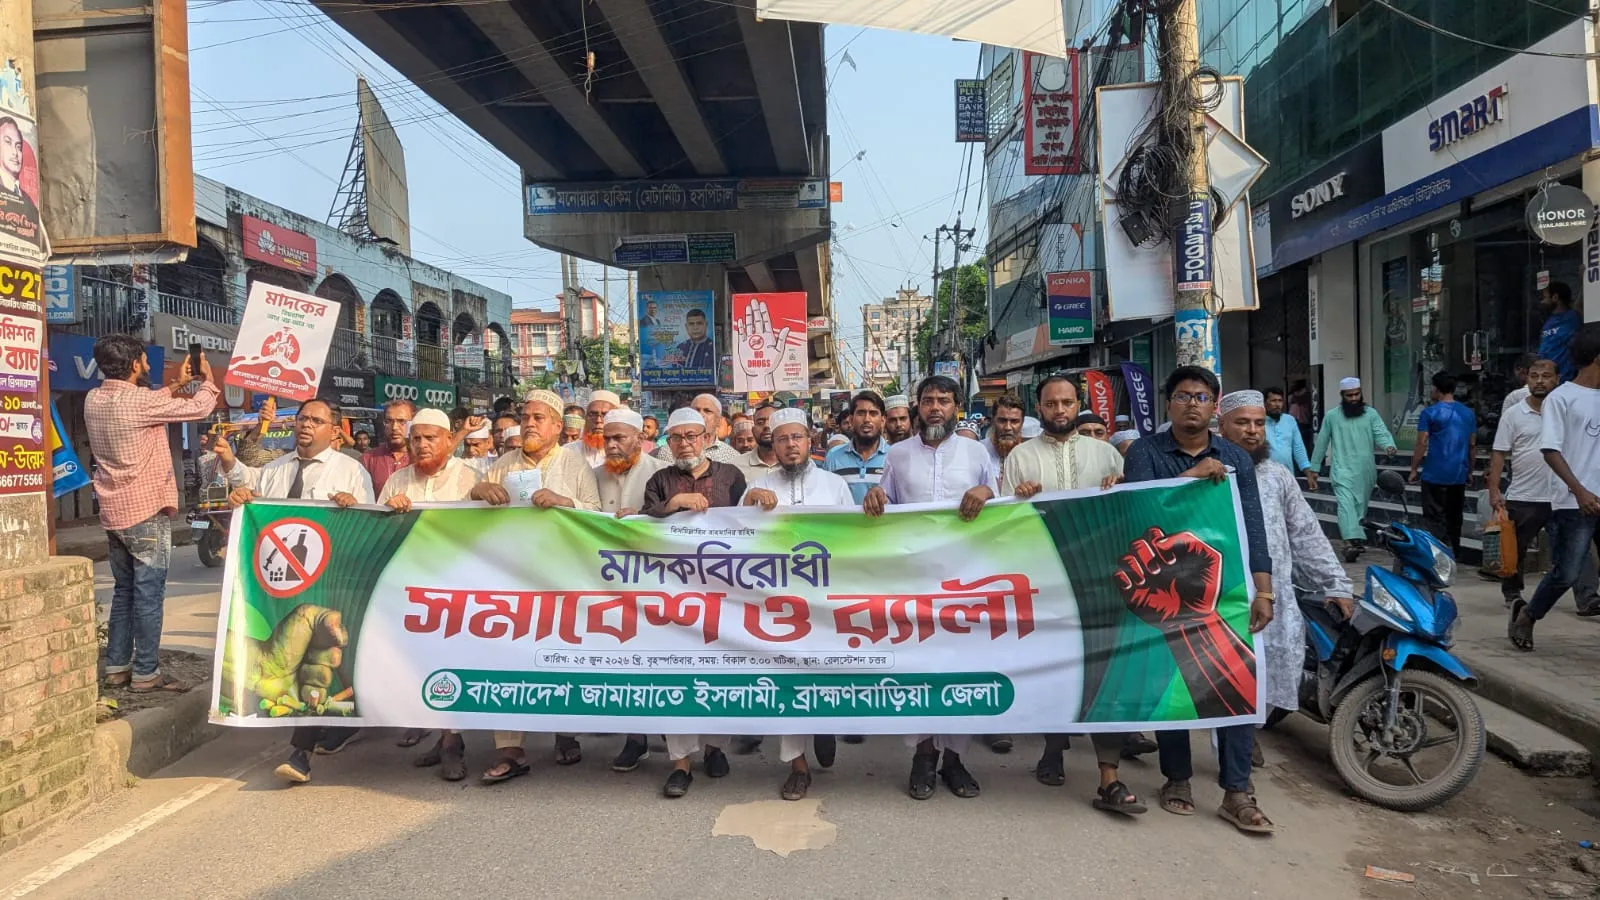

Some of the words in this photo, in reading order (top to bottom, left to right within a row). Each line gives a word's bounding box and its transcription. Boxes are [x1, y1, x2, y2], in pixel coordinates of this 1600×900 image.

[1291, 172, 1346, 218] SONY
[1537, 208, 1586, 221] HONOR
[1538, 221, 1569, 229] AVAILABLE
[1570, 219, 1587, 227] HERE
[1052, 276, 1085, 286] KONKA
[265, 291, 328, 317] মাদকের
[1063, 302, 1086, 310] GREE
[4, 346, 39, 371] ব্যাচ
[753, 351, 764, 359] NO
[747, 359, 771, 368] DRUGS
[333, 376, 364, 390] SAMSUNG
[1130, 371, 1150, 416] GREE
[4, 395, 20, 410] ১০
[598, 540, 831, 590] মাদকবিরোধী
[403, 585, 727, 645] সমাবেশ
[743, 595, 811, 643] ও
[543, 653, 570, 664] তারিখ:
[573, 655, 585, 665] ২৫
[589, 655, 602, 666] জুন
[605, 656, 630, 665] ২০২৬
[698, 656, 719, 665] সময়:
[722, 654, 747, 665] বিকাল
[824, 653, 866, 665] রেলস্টেশন
[465, 679, 574, 708] বাংলাদেশ
[579, 682, 688, 709] জামায়াতে
[693, 677, 785, 714] ইসলামী,
[792, 676, 932, 712] ব্রাহ্মণবাড়িয়া
[941, 679, 1002, 708] জেলা
